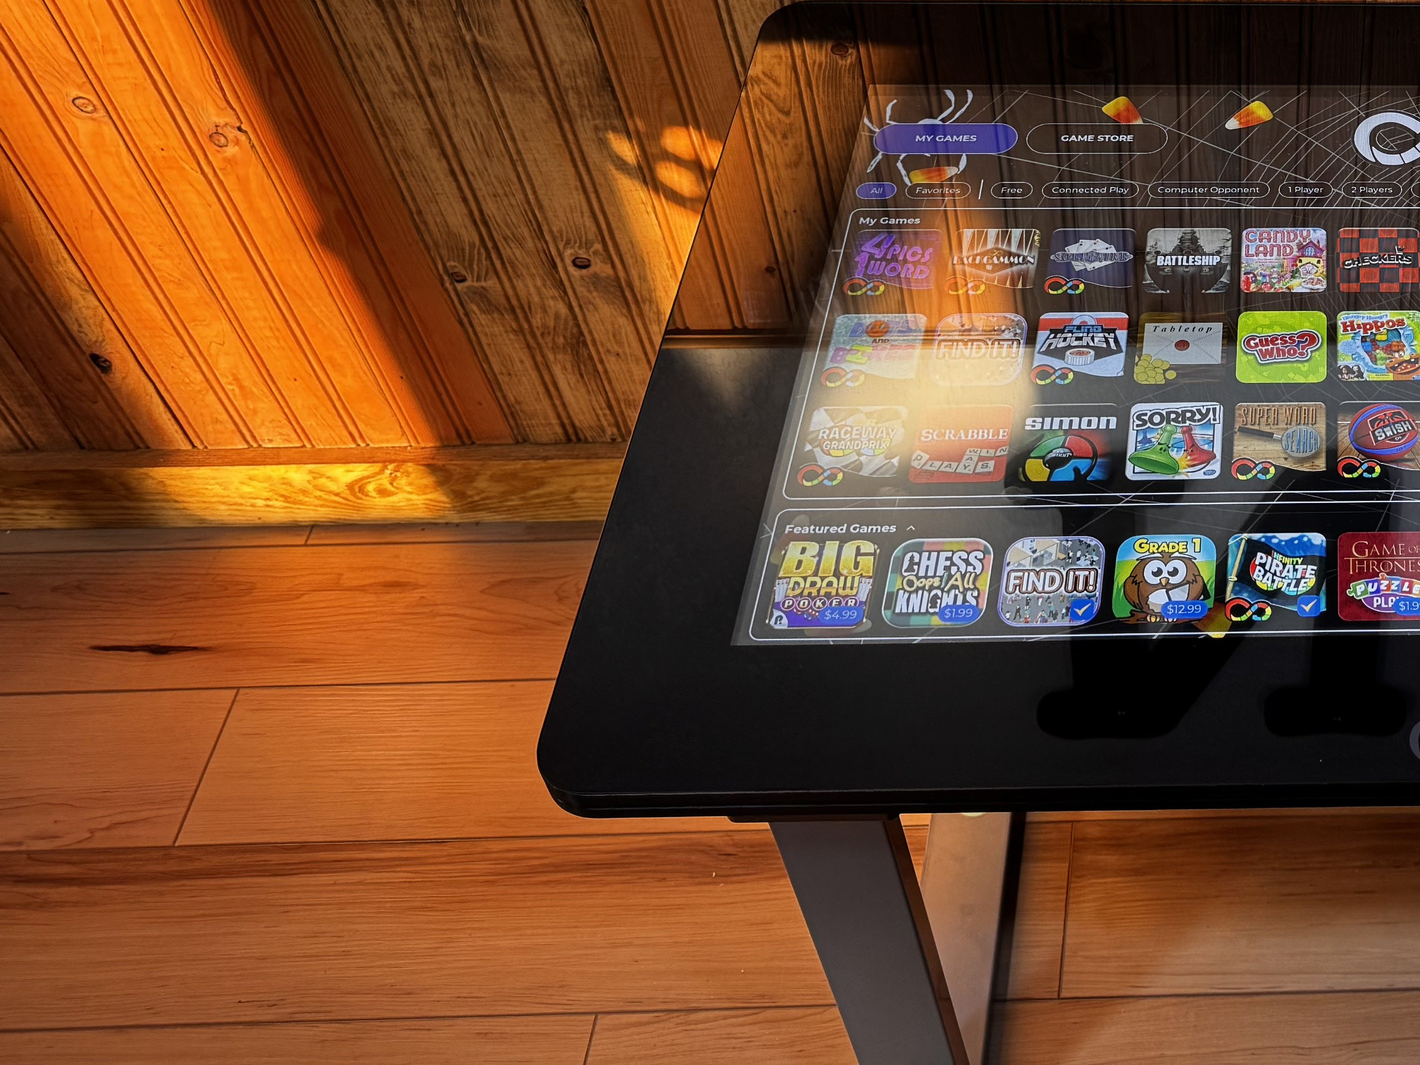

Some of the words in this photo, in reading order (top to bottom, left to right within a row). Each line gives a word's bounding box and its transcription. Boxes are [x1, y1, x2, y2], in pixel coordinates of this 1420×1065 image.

[914, 134, 934, 143] MY
[935, 134, 978, 143] GAMES
[1060, 134, 1095, 143] GAME
[1097, 134, 1135, 143] STORE
[869, 186, 884, 195] All
[915, 186, 962, 195] Favorites
[1000, 186, 1023, 195] Free
[1051, 185, 1108, 195] Connected
[1109, 185, 1130, 196] Play
[1157, 185, 1208, 196] Computer
[1209, 185, 1261, 196] Opponent
[1294, 185, 1324, 196] Player
[1359, 185, 1394, 196] Players
[858, 217, 877, 227] My
[879, 217, 921, 226] Games
[1244, 229, 1312, 245] CANDY
[888, 243, 934, 263] PICS
[1244, 243, 1295, 259] LAND
[1156, 255, 1222, 267] BATTLESHIP
[1343, 253, 1414, 270] CHECKERS
[866, 259, 931, 280] WORD
[1152, 324, 1214, 334] Tabletop
[1341, 316, 1407, 335] Hippos
[936, 339, 990, 360] FIND
[990, 339, 1022, 360] IT!
[1040, 332, 1117, 352] HOCKEY
[1133, 406, 1220, 429] SORRY!
[1240, 407, 1279, 426] SUPER
[1283, 407, 1317, 426] WORD
[817, 426, 898, 440] RACEWAY
[920, 428, 1009, 443] SCRABBLE
[1374, 420, 1414, 442] SWISH
[822, 439, 888, 451] GRANDPRIX
[784, 523, 848, 534] Featured
[849, 523, 897, 534] Games
[1191, 538, 1202, 553] 1
[1351, 540, 1406, 558] GAME
[778, 539, 876, 578] BIG
[901, 550, 985, 577] CHESS
[1255, 551, 1319, 579] PIRATE
[786, 576, 860, 597] DRAW
[945, 571, 976, 593] All
[1007, 570, 1062, 594] FIND
[1065, 569, 1097, 593] IT!
[1253, 565, 1310, 595] BATTLE
[782, 597, 858, 610] POKER
[1373, 596, 1402, 608] PLA
[823, 608, 859, 622] $4.99
[943, 608, 974, 619] $1.99
[1166, 604, 1203, 616] $12.99
